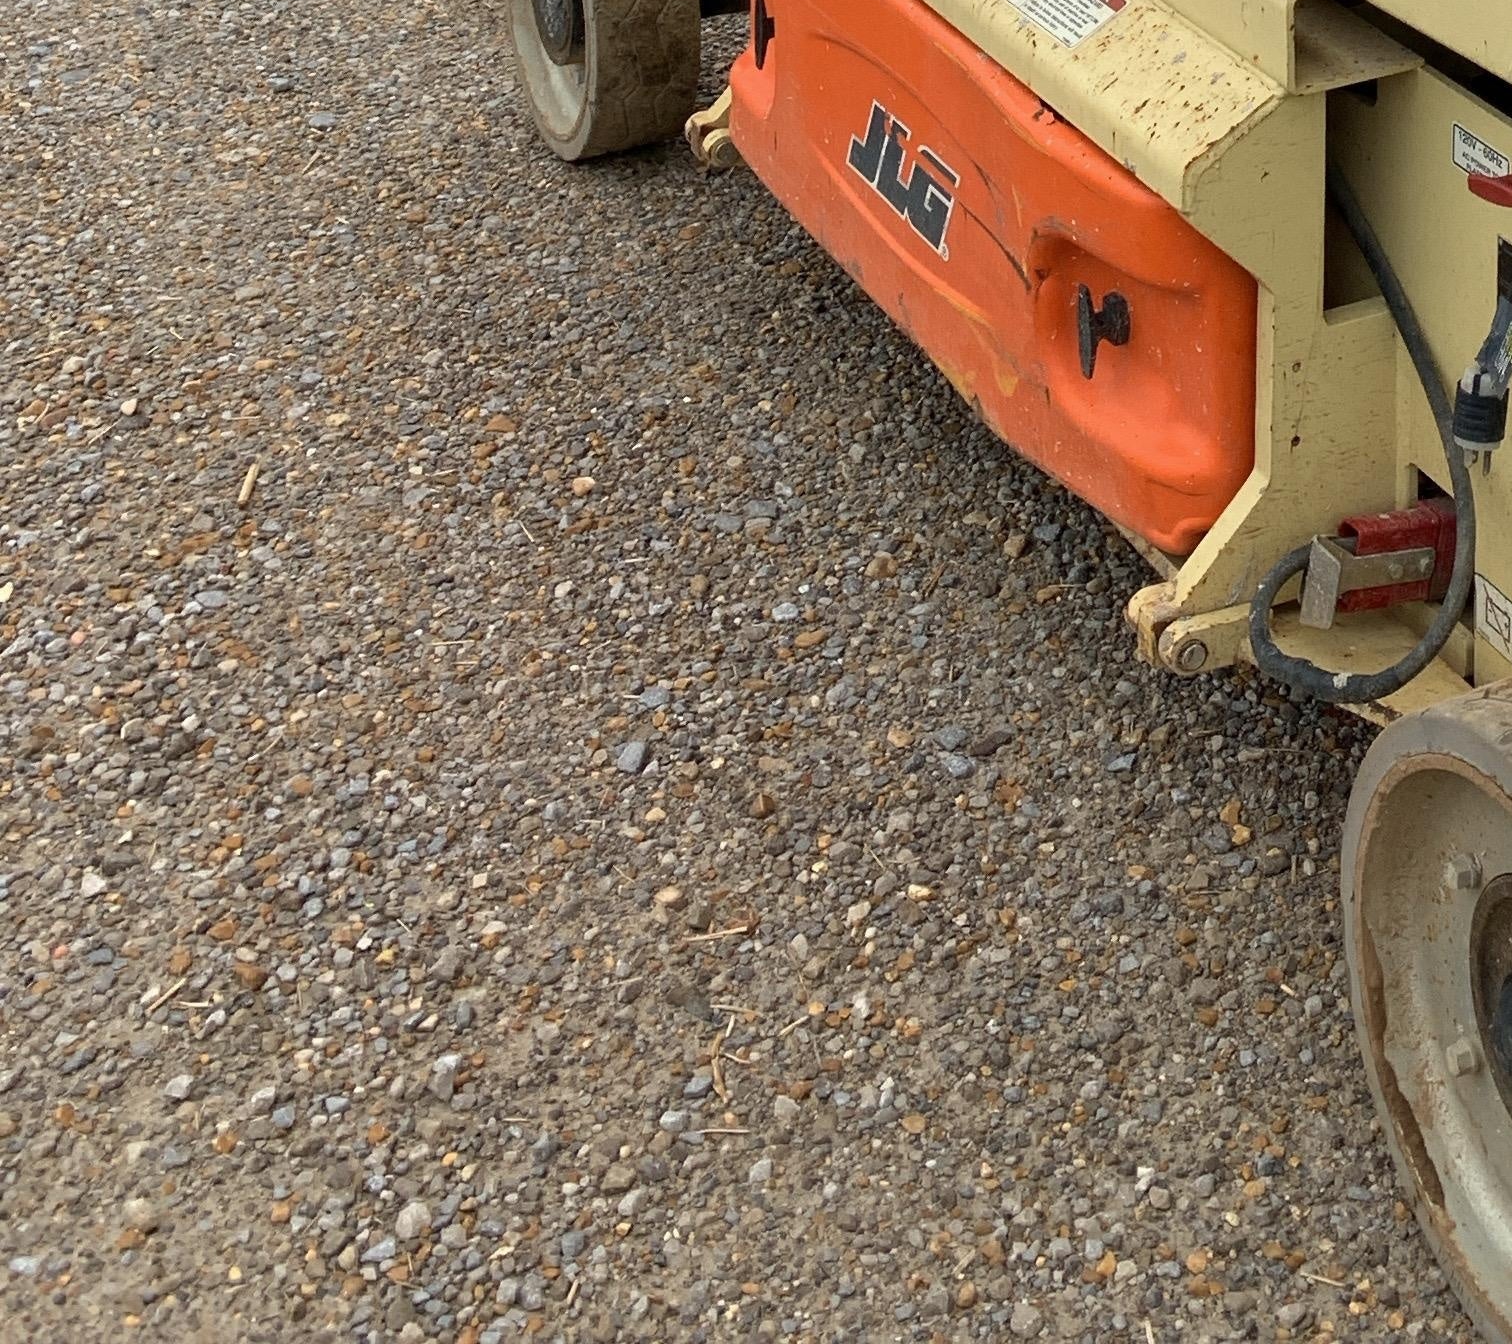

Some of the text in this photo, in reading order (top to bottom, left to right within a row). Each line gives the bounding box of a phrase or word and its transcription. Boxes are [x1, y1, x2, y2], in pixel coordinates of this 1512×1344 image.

[845, 98, 961, 256] JLG
[1458, 130, 1477, 151] 120V
[1482, 146, 1503, 170] 60Hz
